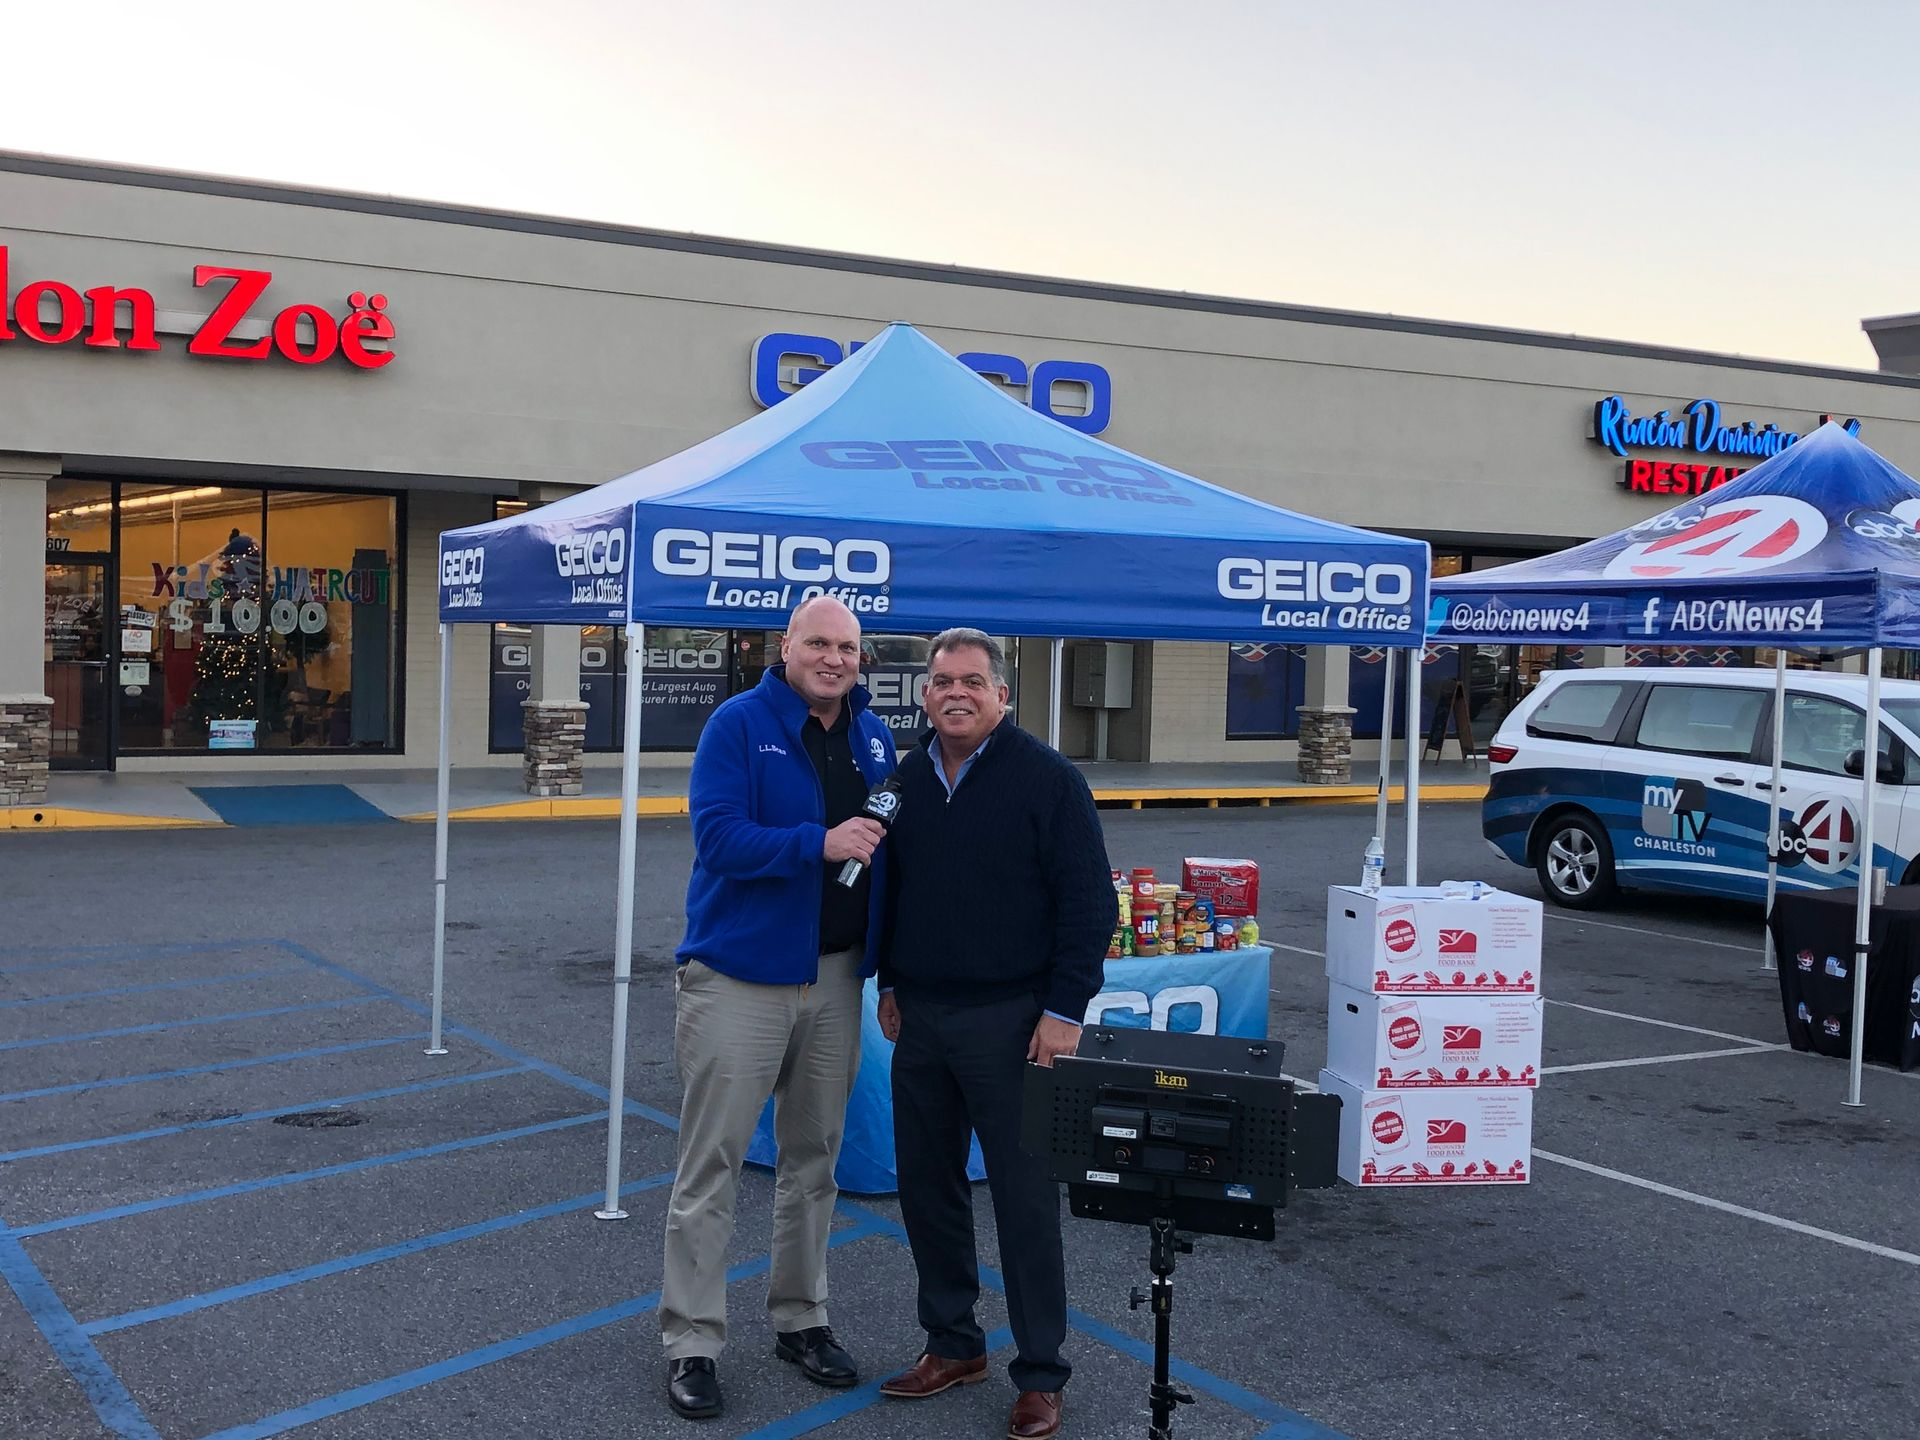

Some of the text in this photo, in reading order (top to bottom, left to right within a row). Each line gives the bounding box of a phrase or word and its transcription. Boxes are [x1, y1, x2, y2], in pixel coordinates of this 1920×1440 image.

[188, 265, 396, 369] Zoë
[751, 332, 1112, 435] GCO
[1600, 395, 1686, 457] Rincón
[800, 440, 1171, 489] GEICO
[1630, 459, 1748, 496] RESTA
[913, 472, 1195, 507] Local Office
[442, 546, 484, 586] GEICO
[555, 527, 625, 577] GEICO
[652, 528, 890, 584] GEICO
[152, 562, 391, 605] Kids HAIRCUT
[449, 586, 483, 608] Local Office
[571, 578, 623, 604] Local Office
[706, 581, 791, 609] Local
[1217, 558, 1412, 605] GEICO
[1261, 604, 1411, 631] Local Office
[1451, 601, 1590, 631] @abcnews4
[1671, 599, 1824, 632] ABCNews4
[651, 681, 690, 692] Largest
[692, 682, 716, 692] Auto
[668, 695, 678, 704] in
[680, 695, 698, 704] the
[700, 695, 714, 704] US
[879, 709, 921, 729] ocal
[1644, 784, 1684, 815] my
[1672, 808, 1713, 843] TV
[1633, 836, 1716, 858] CHARLESTON
[1191, 879, 1225, 888] Ramen
[1220, 894, 1233, 905] 12
[1138, 919, 1159, 934] Jif
[1154, 1070, 1188, 1088] ikan
